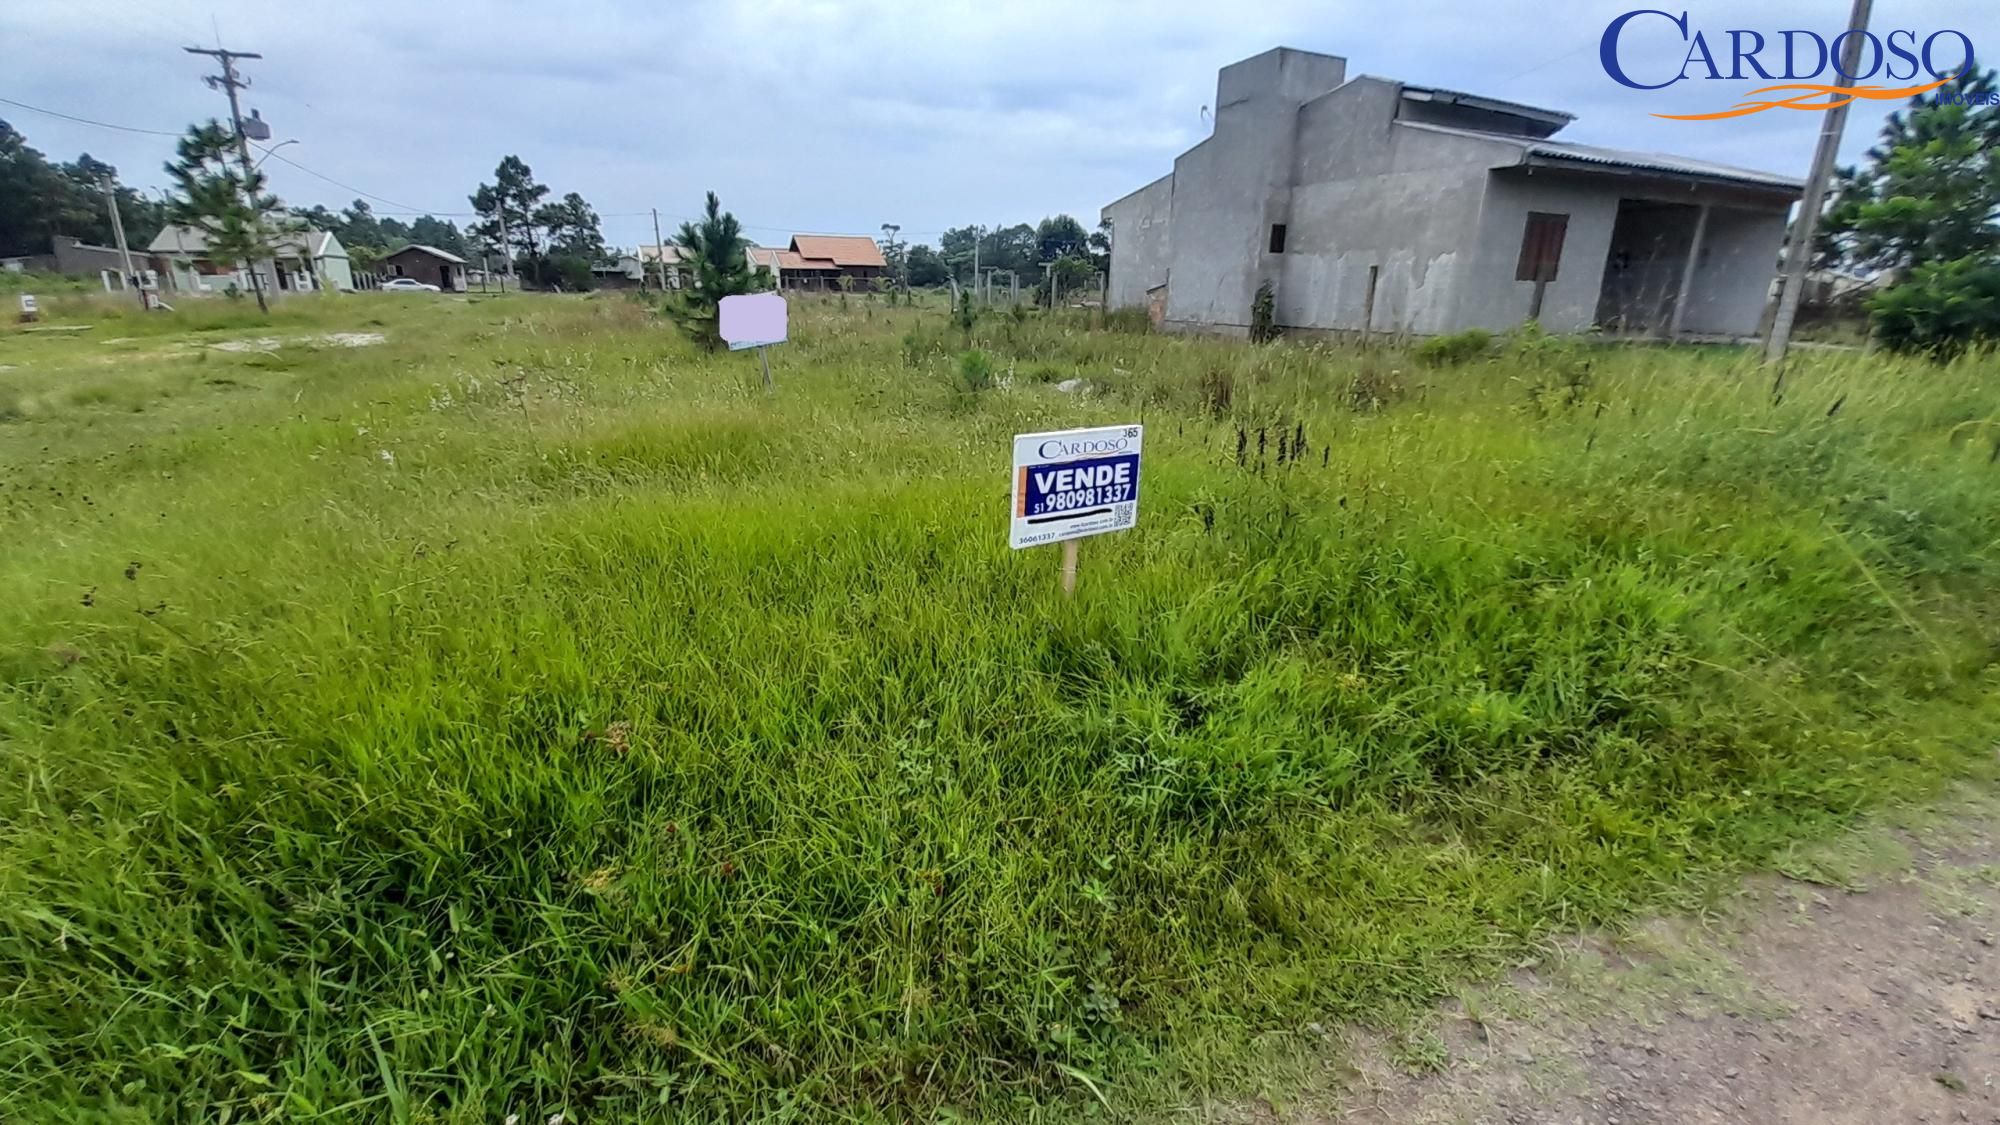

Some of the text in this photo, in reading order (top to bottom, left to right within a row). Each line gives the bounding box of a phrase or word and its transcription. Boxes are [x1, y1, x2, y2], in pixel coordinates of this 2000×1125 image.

[1038, 439, 1127, 459] CARDOSO
[1034, 462, 1131, 494] VENDE
[1034, 484, 1131, 513] 51 980981337
